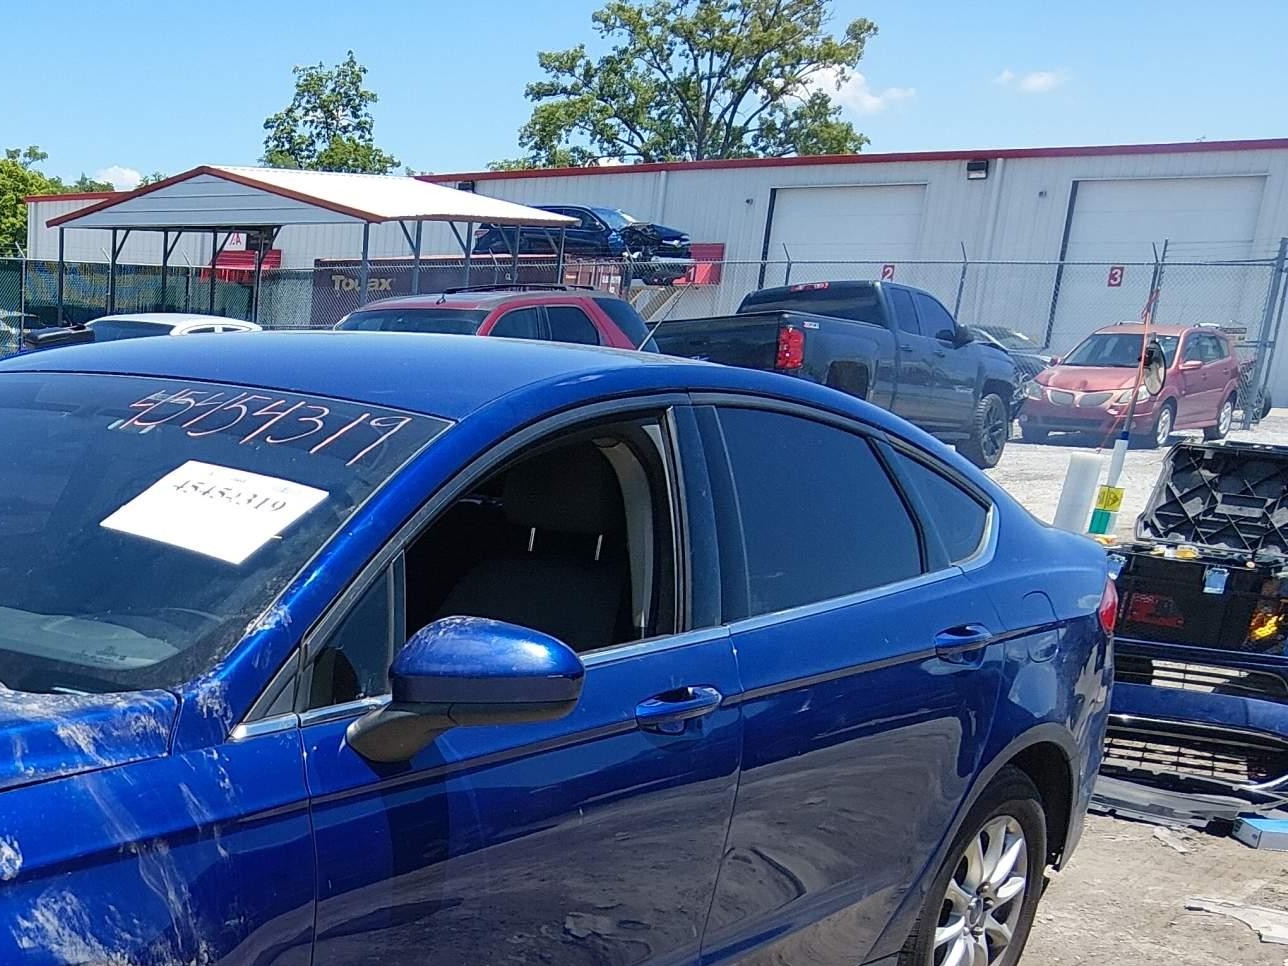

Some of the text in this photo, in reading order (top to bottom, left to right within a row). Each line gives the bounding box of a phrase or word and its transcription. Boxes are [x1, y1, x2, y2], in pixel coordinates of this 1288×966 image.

[688, 266, 696, 282] 1
[883, 265, 893, 281] 2
[1110, 269, 1122, 285] 3
[119, 388, 412, 466] 45454319
